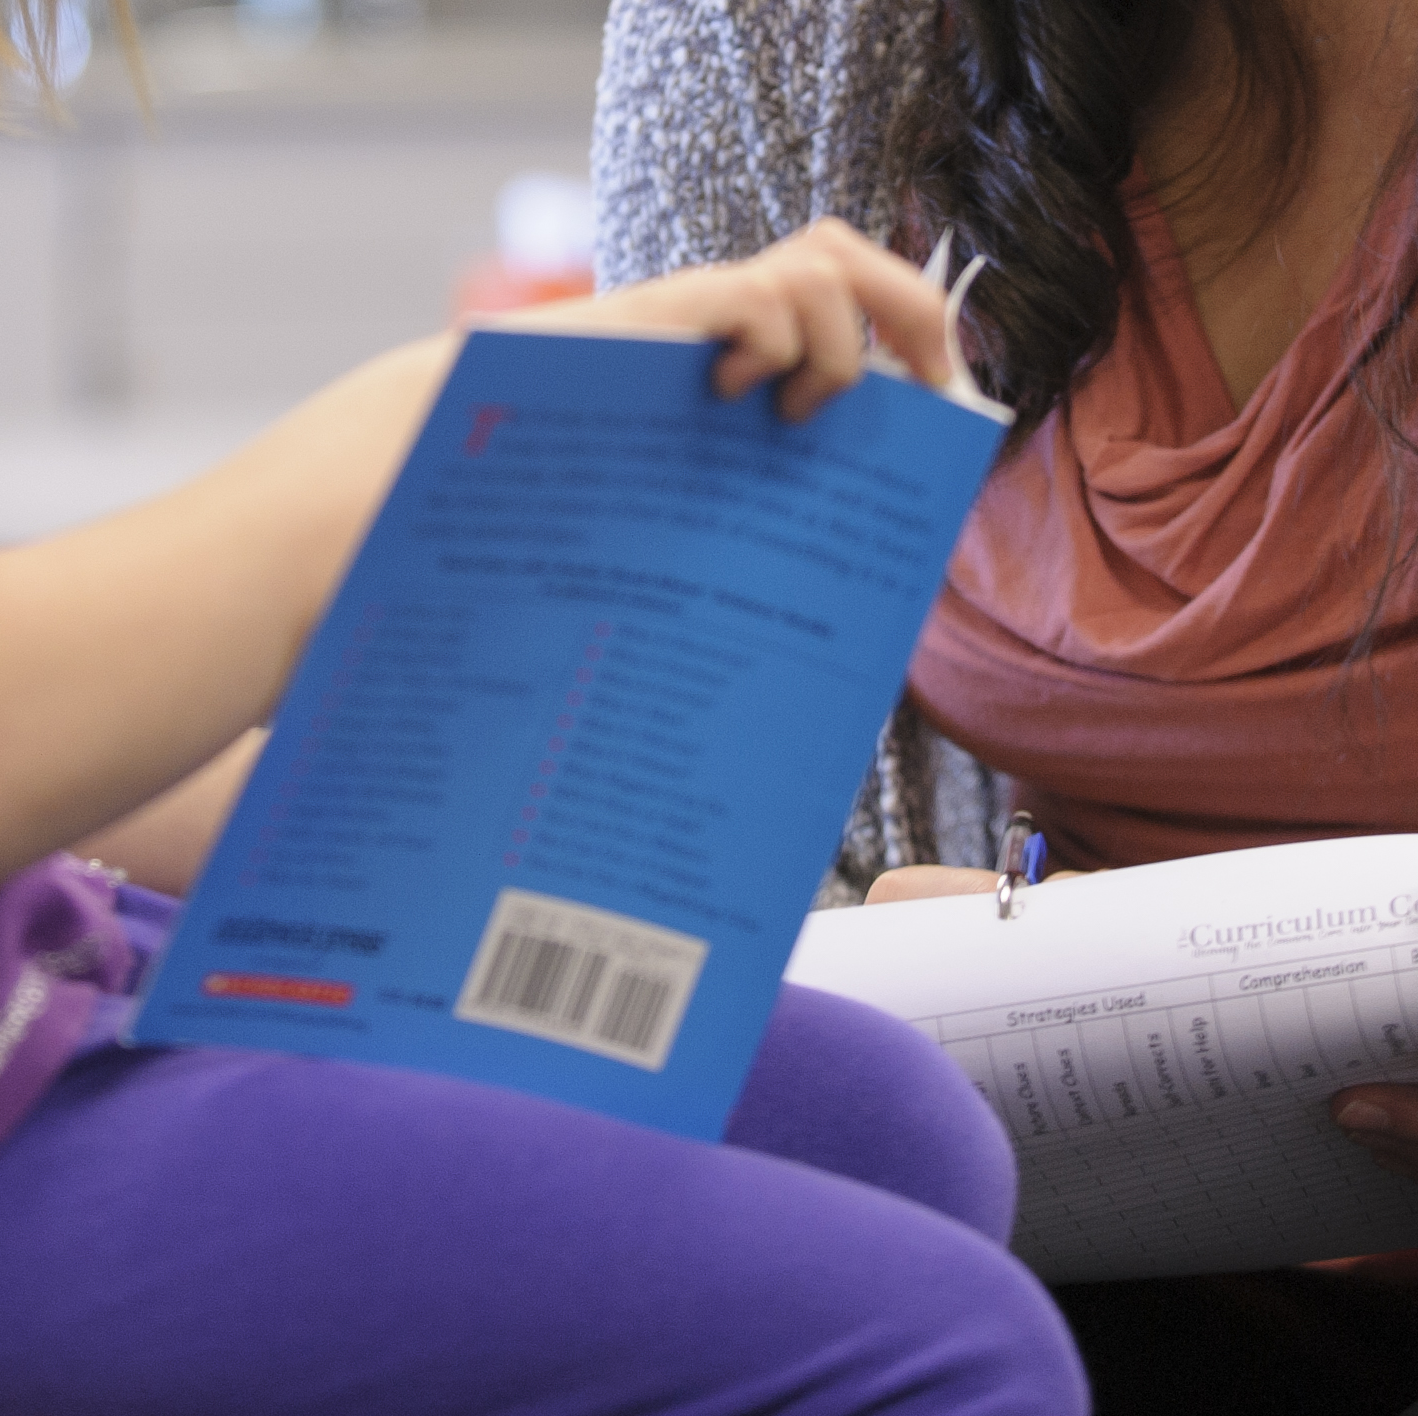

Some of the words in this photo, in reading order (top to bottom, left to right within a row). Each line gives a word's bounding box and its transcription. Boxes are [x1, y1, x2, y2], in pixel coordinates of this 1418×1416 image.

[1188, 905, 1377, 948] Curriculum
[1238, 959, 1368, 991] Comprehension
[1006, 1001, 1098, 1027] Strategies
[1101, 992, 1147, 1013] Used
[1189, 1016, 1210, 1054] Help
